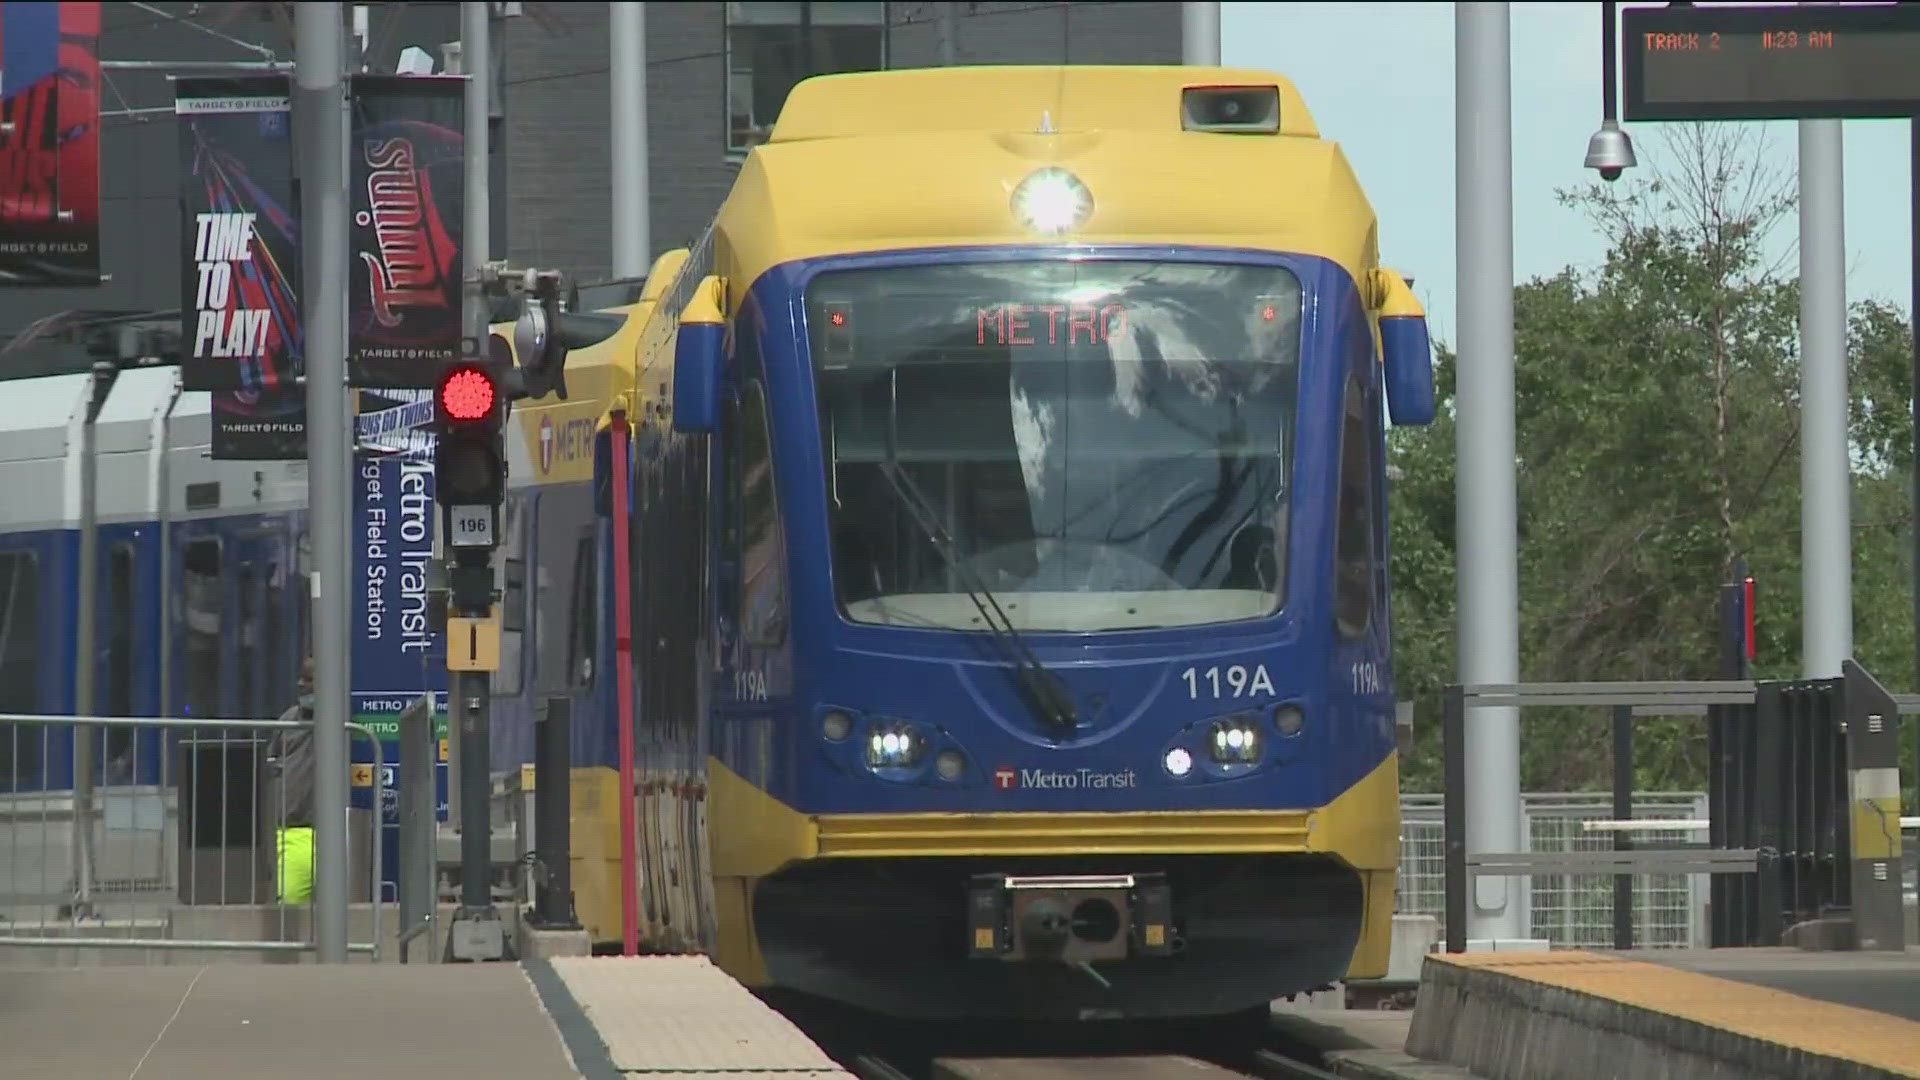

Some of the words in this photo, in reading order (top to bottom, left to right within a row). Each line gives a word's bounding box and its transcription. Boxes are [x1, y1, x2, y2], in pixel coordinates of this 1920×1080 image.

[1644, 32, 1699, 51] TRACK
[1710, 32, 1721, 51] 2
[1808, 31, 1833, 49] AM
[188, 101, 233, 110] TARGET
[245, 100, 280, 108] FIELD
[48, 242, 89, 253] FIELD
[195, 213, 256, 262] TIME
[196, 262, 231, 310] TO
[193, 310, 270, 358] PLAY!
[976, 303, 1128, 345] METRO
[360, 348, 406, 358] TARGET
[222, 424, 263, 433] TARGET
[272, 424, 304, 433] FIELD
[382, 410, 398, 433] GO
[400, 400, 433, 429] TWINS
[556, 416, 599, 461] METR
[366, 507, 387, 559] Field
[459, 518, 486, 532] 196
[366, 564, 387, 640] Station
[400, 542, 436, 653] Transit
[734, 669, 768, 702] 119A
[1182, 664, 1276, 701] 119A
[1351, 661, 1379, 696] 119A
[362, 701, 402, 711] METRO
[1020, 768, 1077, 790] Metro
[1077, 768, 1136, 789] Transit
